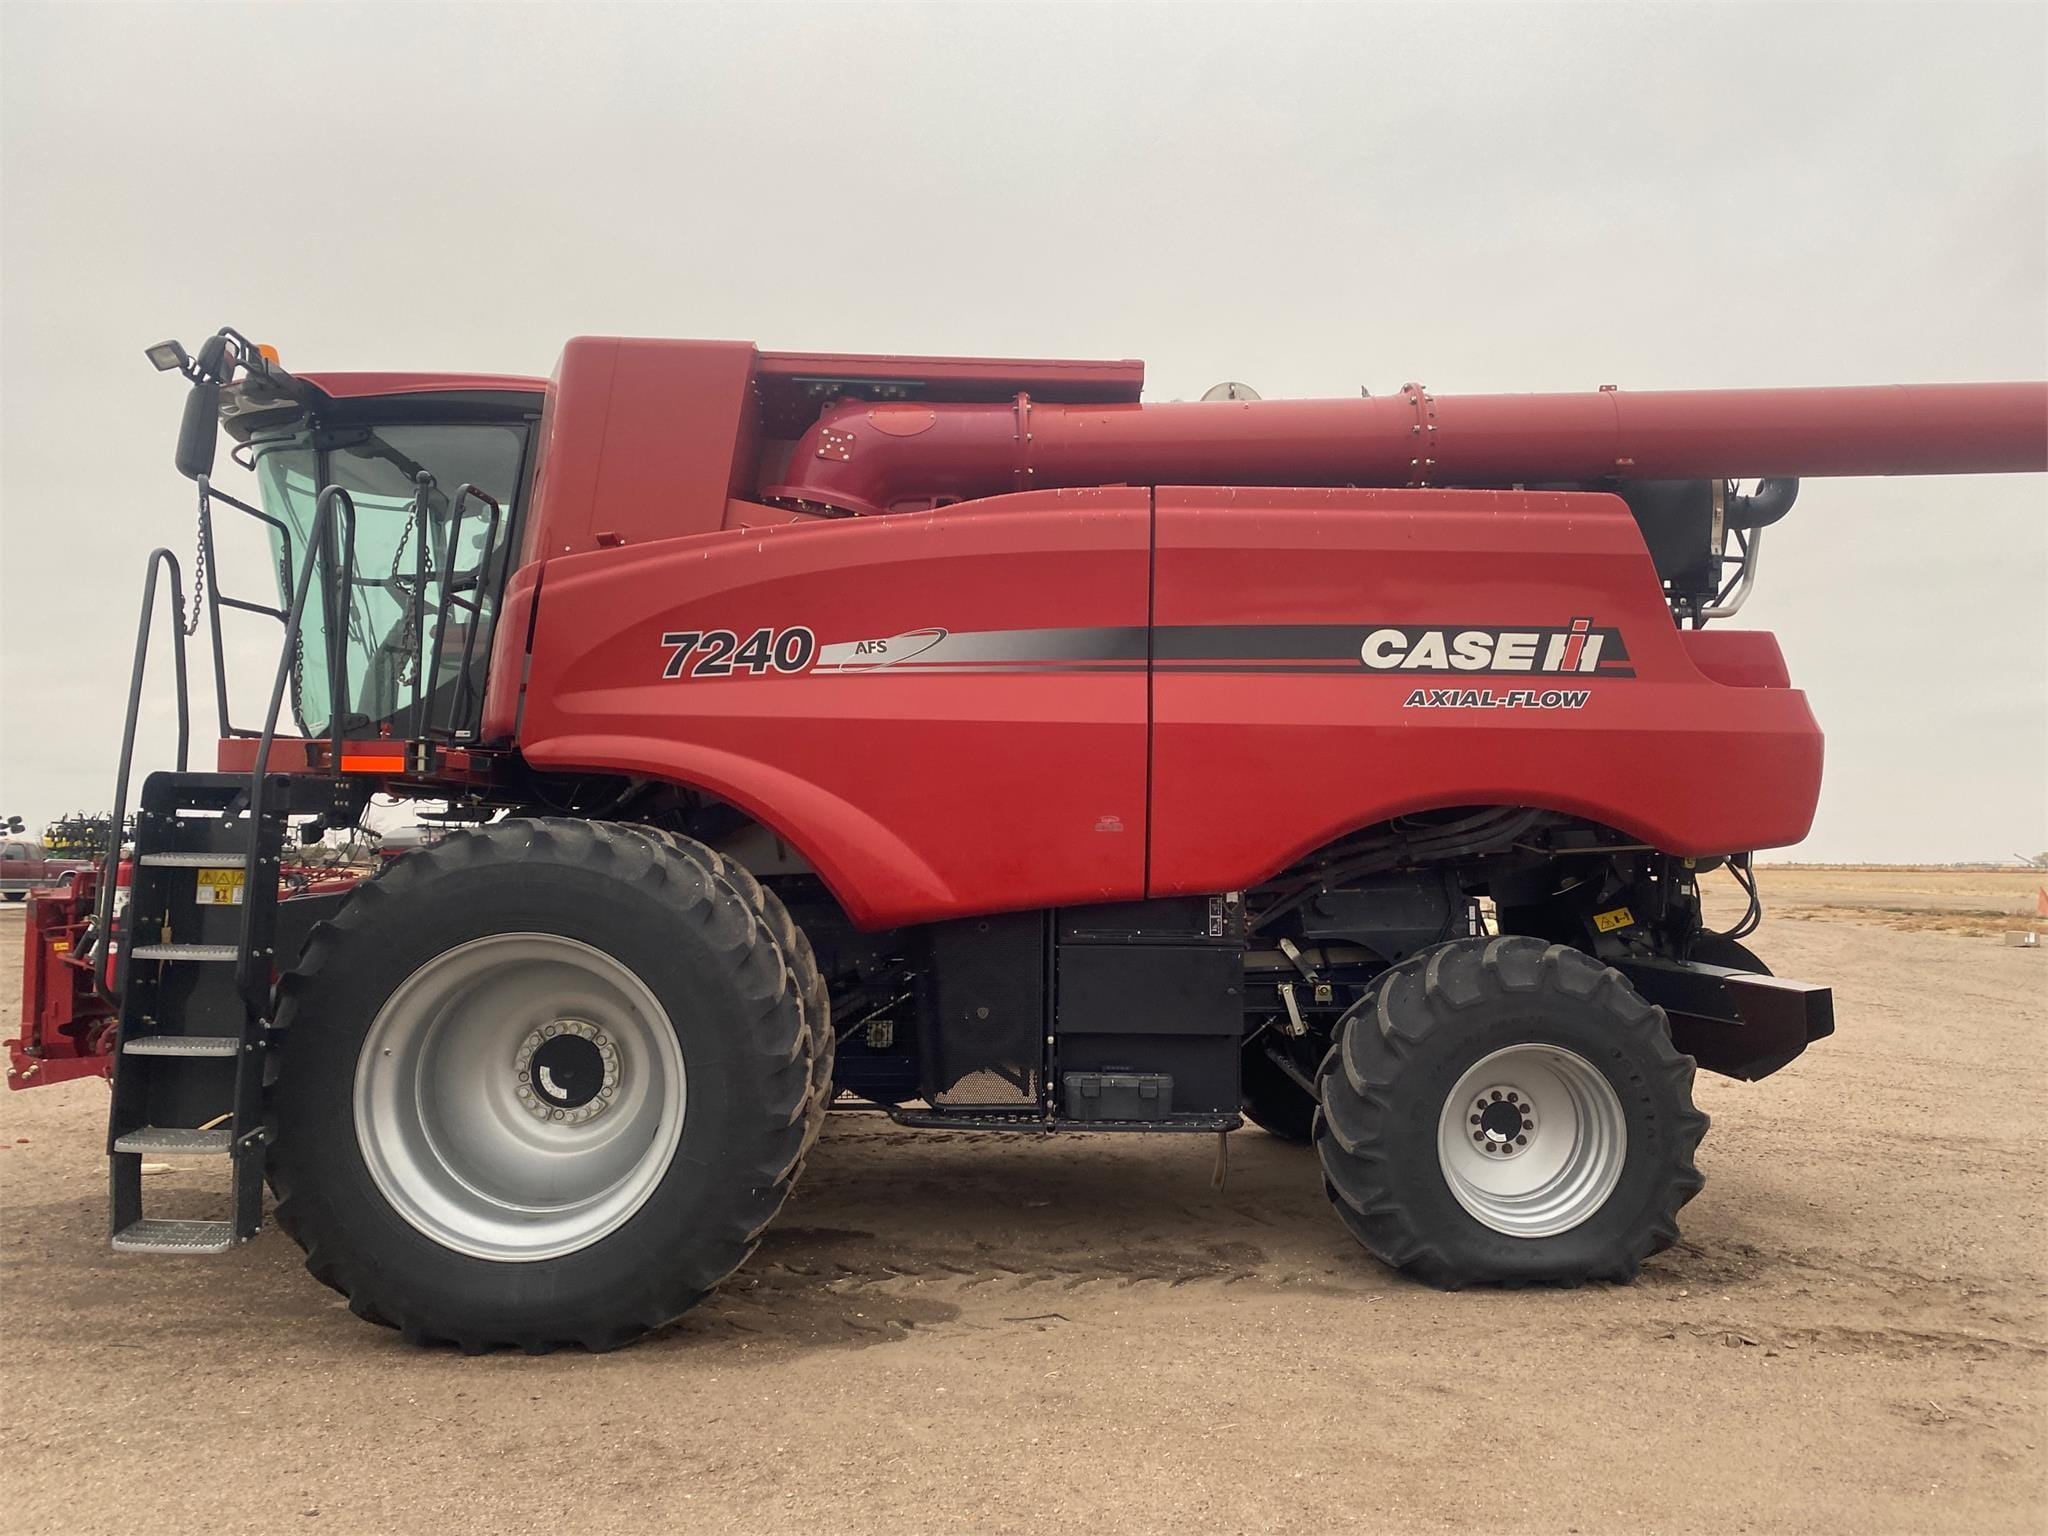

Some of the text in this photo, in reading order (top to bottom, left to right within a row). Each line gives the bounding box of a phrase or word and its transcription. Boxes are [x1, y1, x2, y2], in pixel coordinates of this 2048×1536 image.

[660, 625, 815, 679] 7240
[854, 640, 888, 655] AFS
[1361, 628, 1540, 670] CASE
[1403, 689, 1591, 709] AXIAL-FLOW
